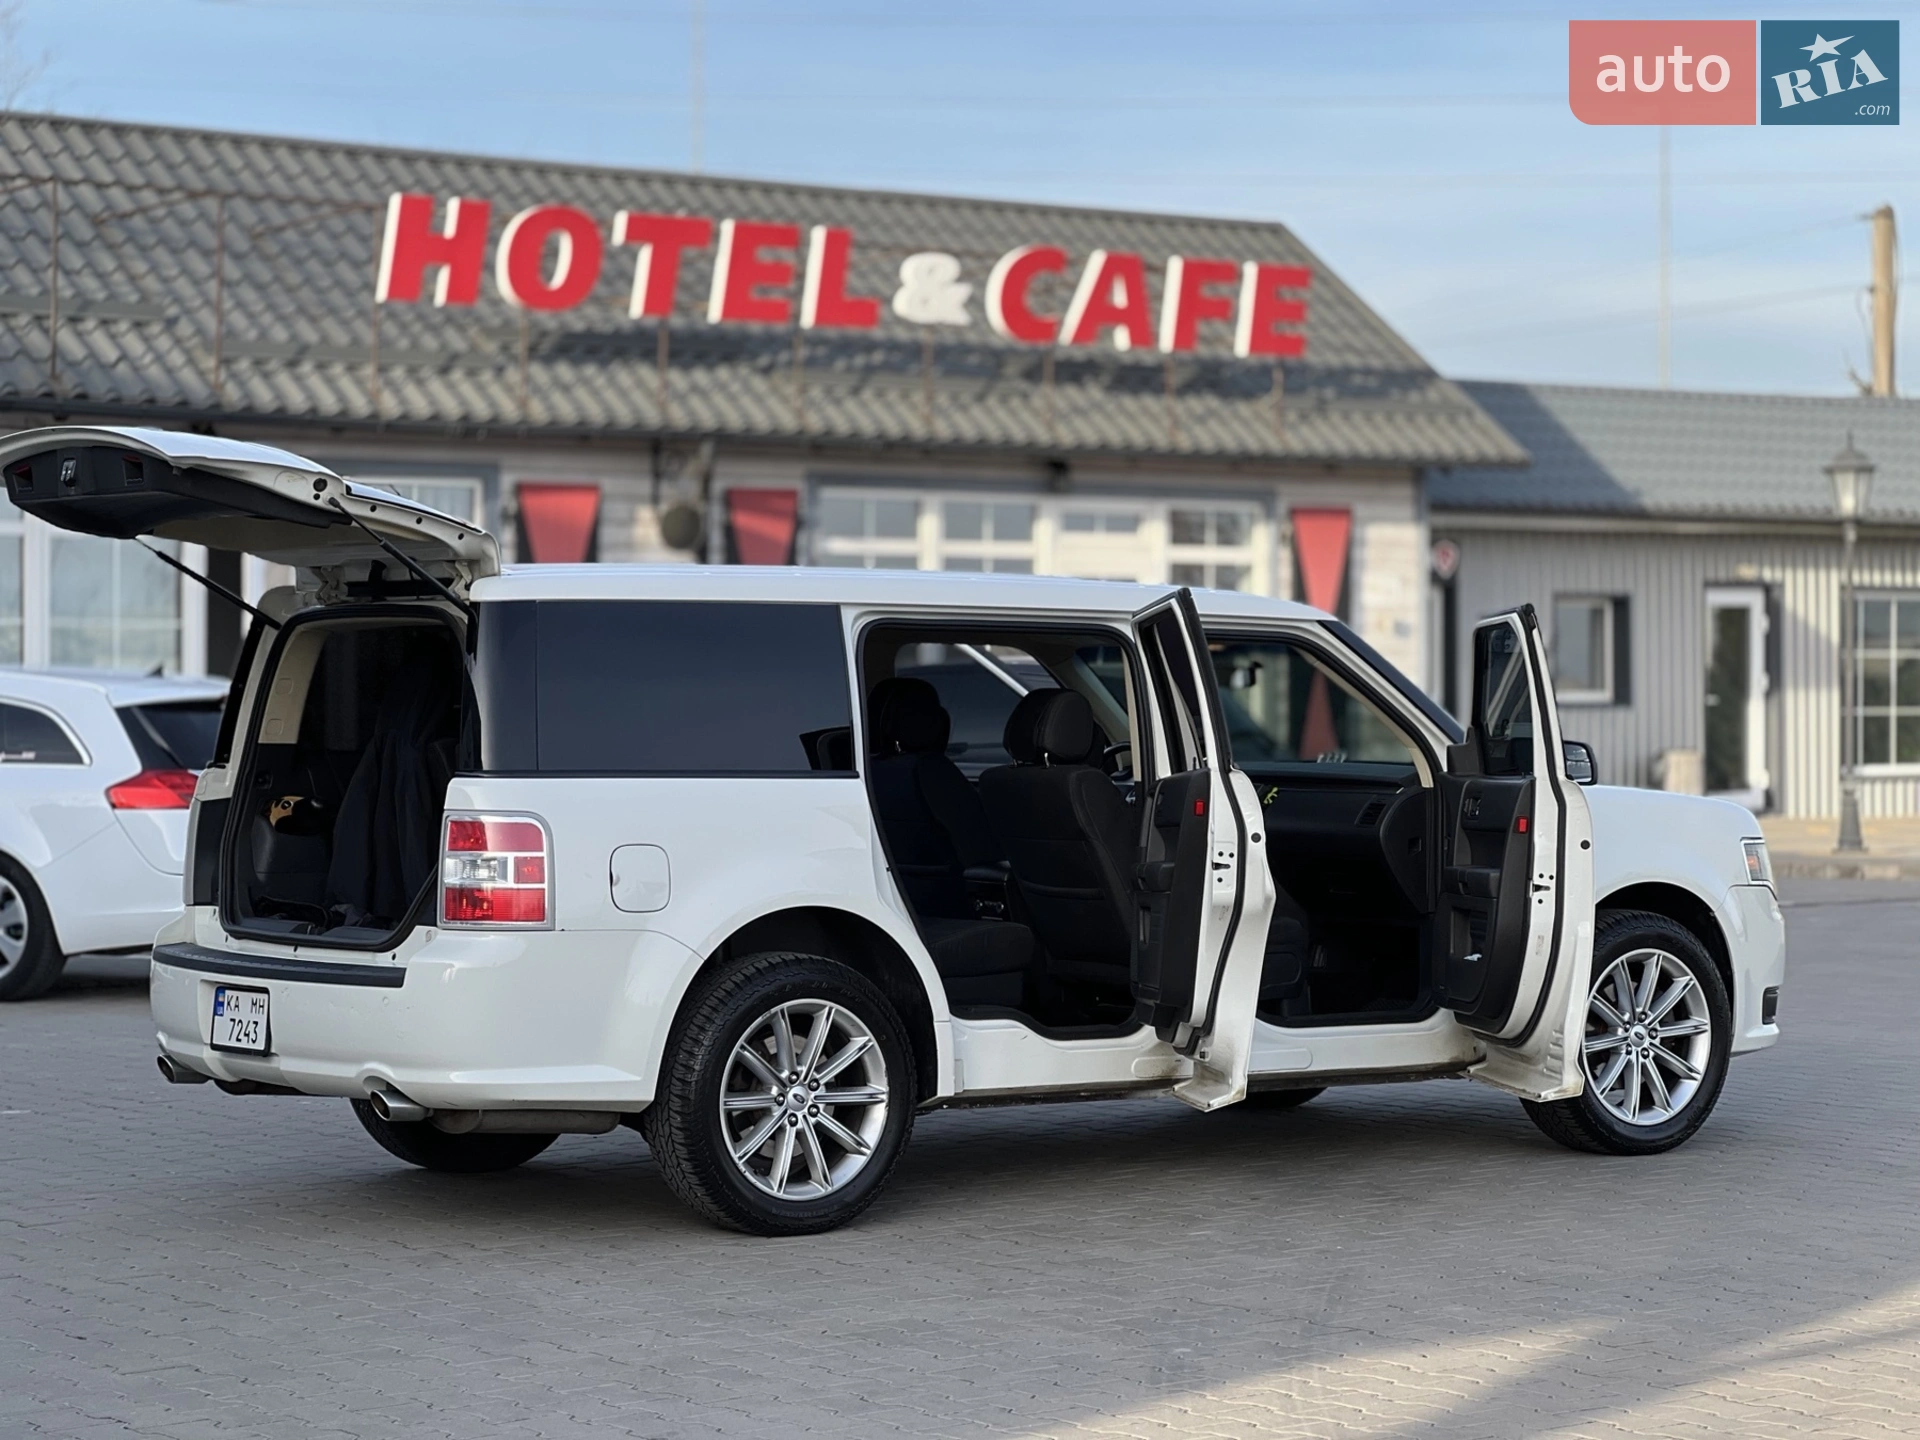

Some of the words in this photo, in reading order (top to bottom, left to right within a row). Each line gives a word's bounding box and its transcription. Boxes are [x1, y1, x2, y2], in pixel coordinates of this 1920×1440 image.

[375, 192, 881, 330] HOTEL
[892, 252, 973, 325] &
[985, 244, 1312, 358] CAFE
[226, 995, 240, 1012] KA
[251, 997, 265, 1015] MH
[228, 1018, 258, 1043] 7243
